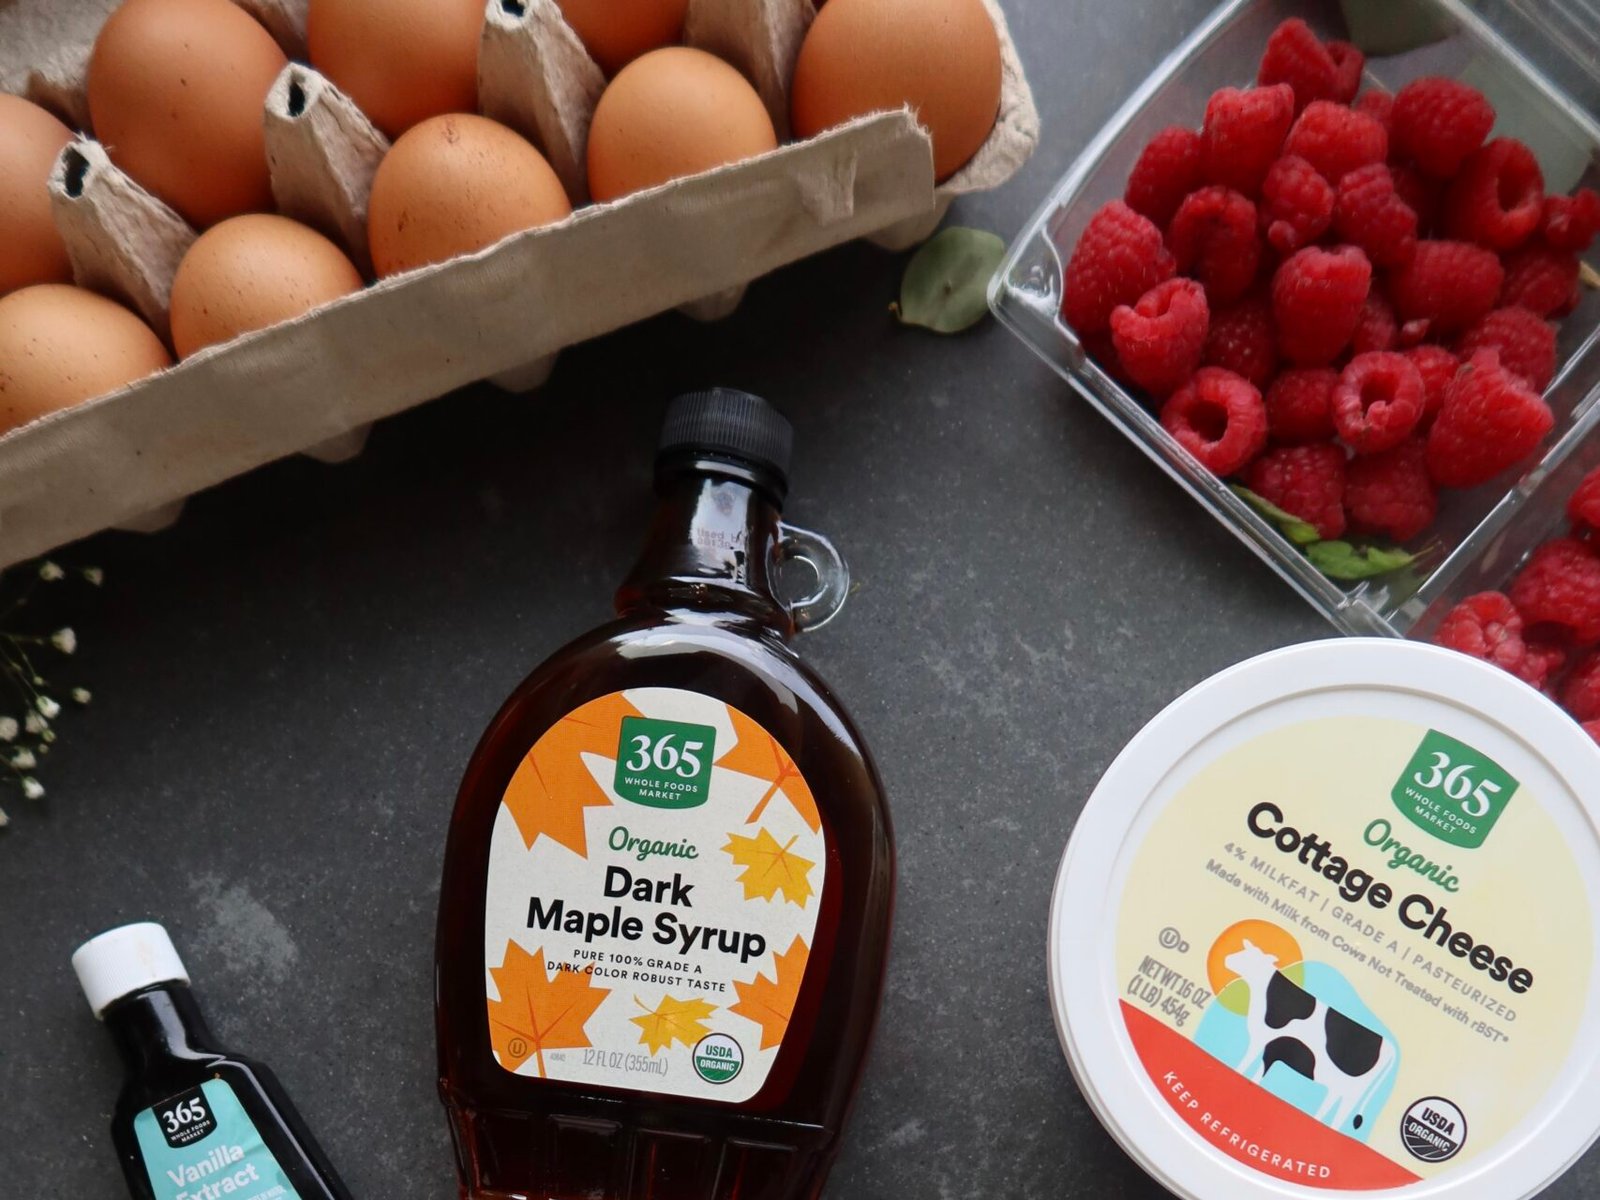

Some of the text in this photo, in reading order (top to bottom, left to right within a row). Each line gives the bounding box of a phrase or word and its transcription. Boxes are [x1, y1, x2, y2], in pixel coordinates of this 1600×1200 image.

[626, 734, 704, 777] 365
[624, 777, 698, 792] WHOLE FOODS
[639, 789, 680, 800] MARKET
[1414, 752, 1502, 817] 365
[1405, 787, 1477, 834] WHOLE FOODS
[1415, 806, 1456, 834] MARKET
[608, 826, 699, 861] Organic
[1363, 818, 1460, 893] Organic
[603, 865, 694, 908] Dark
[1247, 801, 1534, 994] Cottage Cheese
[526, 896, 766, 964] Maple Syrup
[1206, 859, 1242, 887] Made
[1243, 882, 1270, 905] with
[1271, 898, 1301, 923] Milk
[1300, 916, 1330, 941] from
[1332, 935, 1366, 962] Cows
[1368, 956, 1392, 978] Not
[1394, 971, 1441, 1007] Treated
[1443, 1002, 1470, 1025] with
[1224, 842, 1247, 861] 4%
[1250, 856, 1319, 902] MILKFAT
[1332, 906, 1386, 943] GRADE
[1386, 940, 1397, 953] A
[1412, 954, 1517, 1022] PASTEURIZED
[548, 961, 726, 992] DARK COLOR ROBUST TASTE
[574, 950, 702, 974] PURE 100% GRADE A
[1138, 955, 1211, 1009] NET WT 16 OZ
[1128, 974, 1190, 1027] (1 LB) 454g
[583, 1049, 594, 1066] 12
[596, 1050, 606, 1066] FL
[609, 1052, 623, 1068] OZ
[625, 1054, 668, 1077] (355mL)
[700, 1059, 734, 1071] ORGANIC
[706, 1045, 732, 1058] USDA
[163, 1097, 206, 1133] 365
[170, 1119, 211, 1143] WHOLE FOODS
[1163, 1071, 1331, 1179] KEEP REFRIGERATED
[1422, 1107, 1455, 1136] USDA
[182, 1129, 204, 1143] MARKET
[1409, 1122, 1450, 1152] ORGANIC
[166, 1143, 245, 1188] Vanilla
